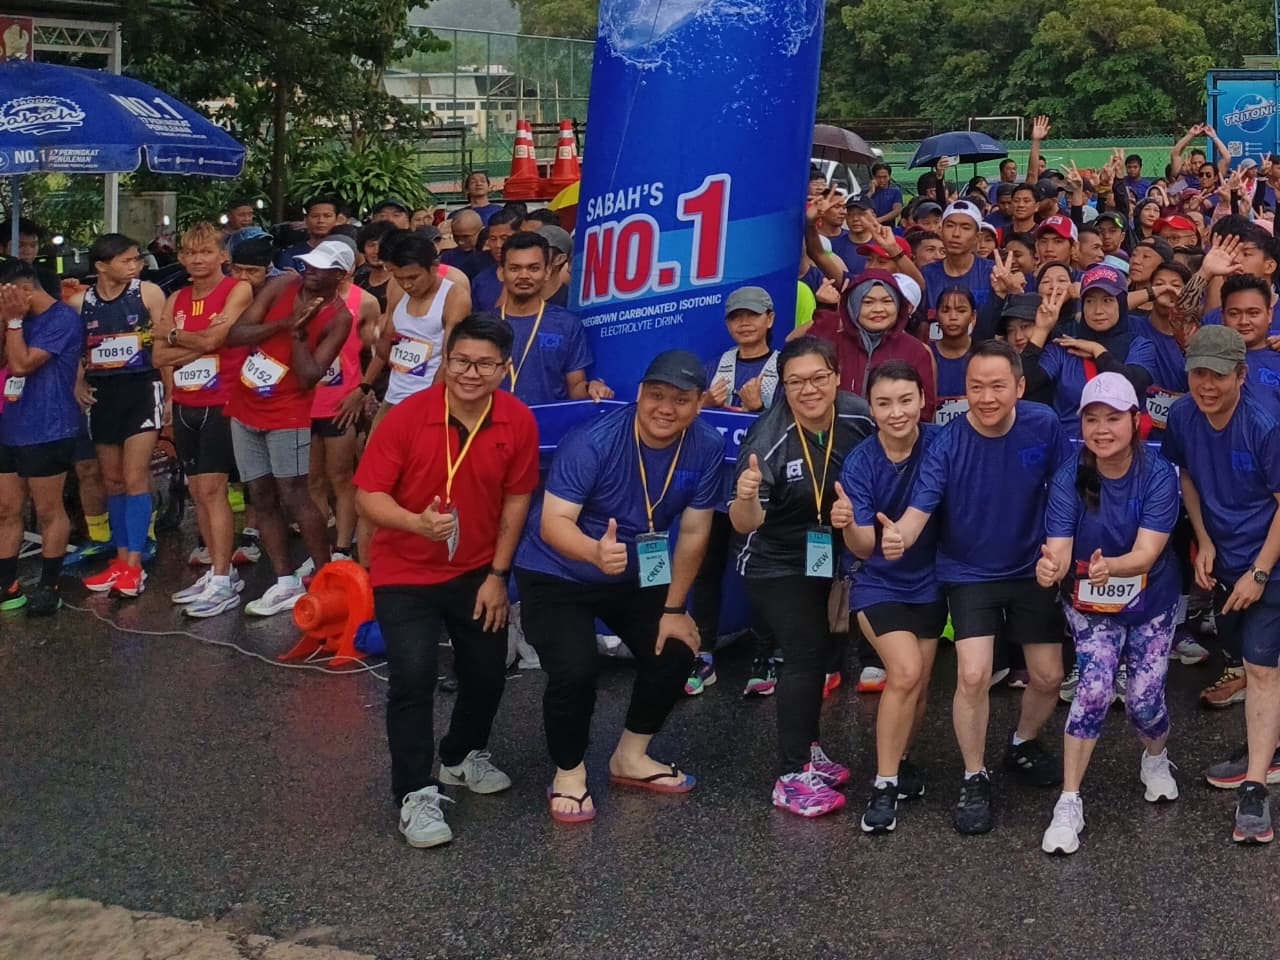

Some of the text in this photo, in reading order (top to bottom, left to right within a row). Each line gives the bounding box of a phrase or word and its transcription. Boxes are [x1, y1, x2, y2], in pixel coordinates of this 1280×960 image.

[586, 182, 664, 222] SABAH'S
[619, 300, 677, 320] CARBONATED
[679, 294, 722, 310] ISOTONIC
[600, 313, 684, 338] ELECTROLYTE DRINK
[97, 346, 134, 358] T0816
[393, 347, 421, 364] T1230
[179, 368, 211, 381] T0973
[245, 359, 273, 384] T0152
[1149, 400, 1169, 417] T02
[646, 558, 666, 583] CREW
[811, 551, 829, 573] CREW
[1088, 582, 1135, 598] T0897
